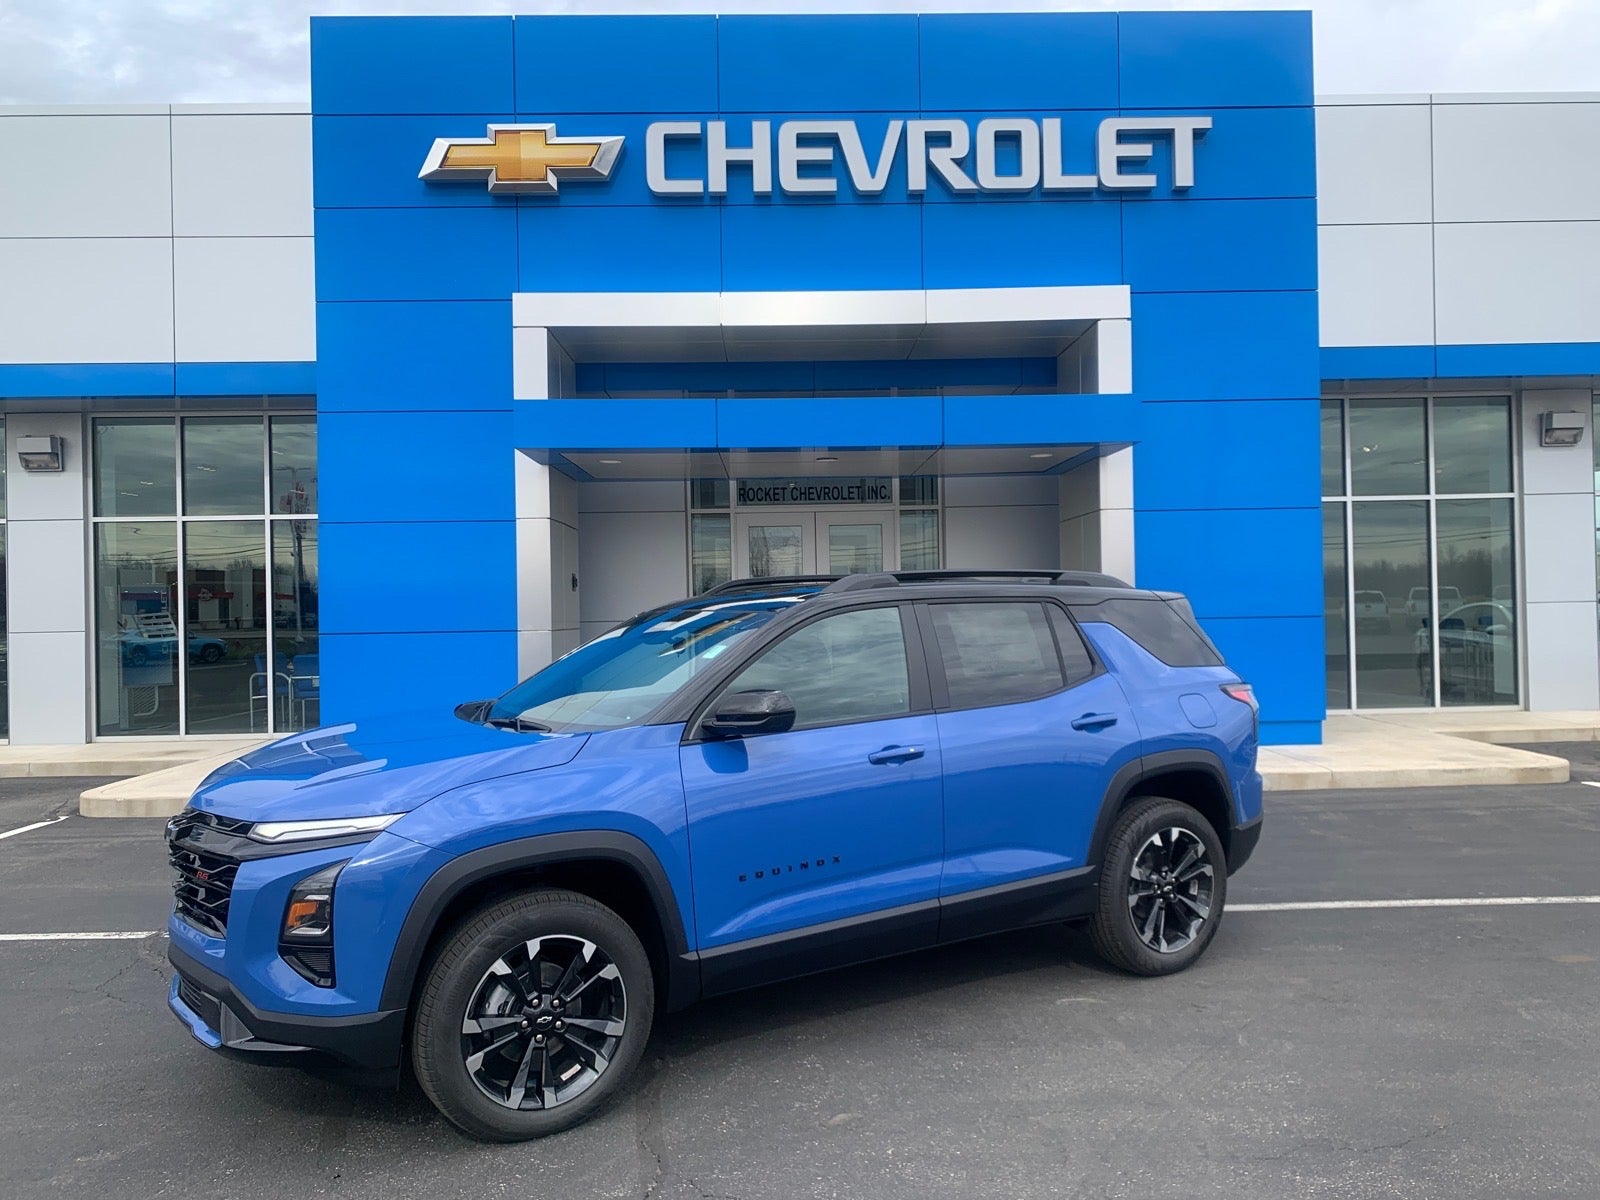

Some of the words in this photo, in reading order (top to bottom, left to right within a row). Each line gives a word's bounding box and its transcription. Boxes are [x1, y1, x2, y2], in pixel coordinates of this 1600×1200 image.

[645, 117, 1213, 197] CHEVROLET
[738, 487, 788, 502] ROCKET
[867, 485, 891, 500] INC.
[196, 871, 209, 880] RS
[739, 856, 840, 882] EQUINOX
